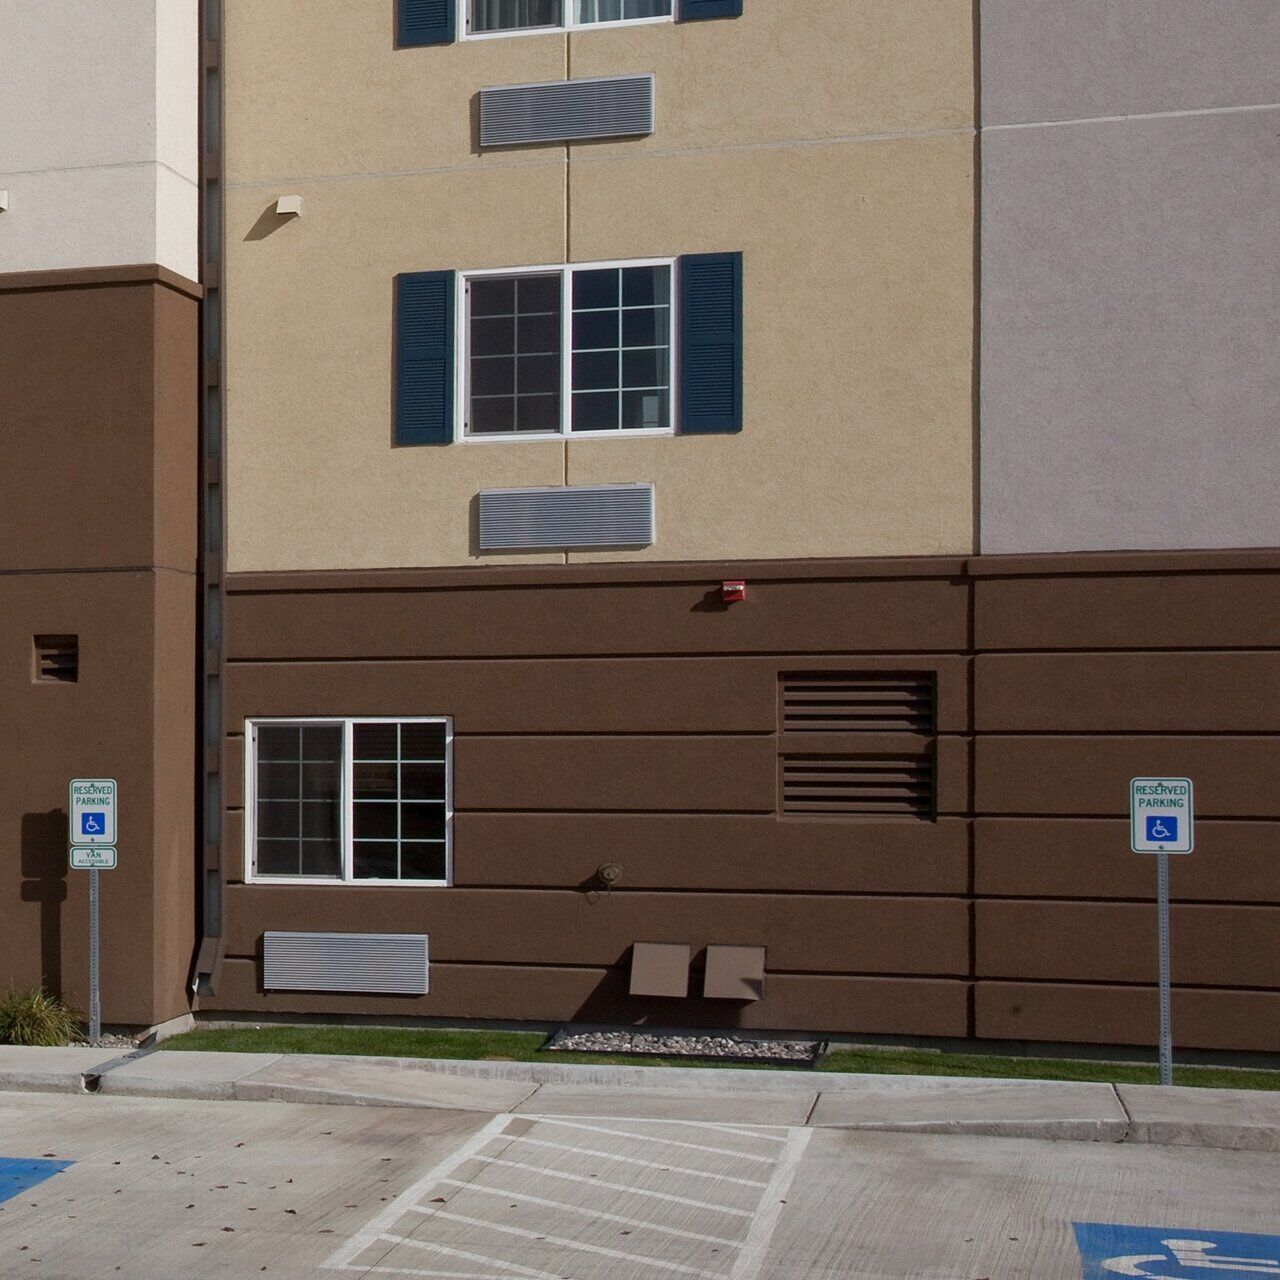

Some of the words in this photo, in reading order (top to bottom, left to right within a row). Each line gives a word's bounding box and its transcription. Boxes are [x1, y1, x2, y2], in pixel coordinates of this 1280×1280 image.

[74, 786, 112, 795] RESERVED
[1135, 785, 1187, 795] RESERVED
[76, 797, 110, 806] PARKING
[1139, 798, 1184, 808] PARKING
